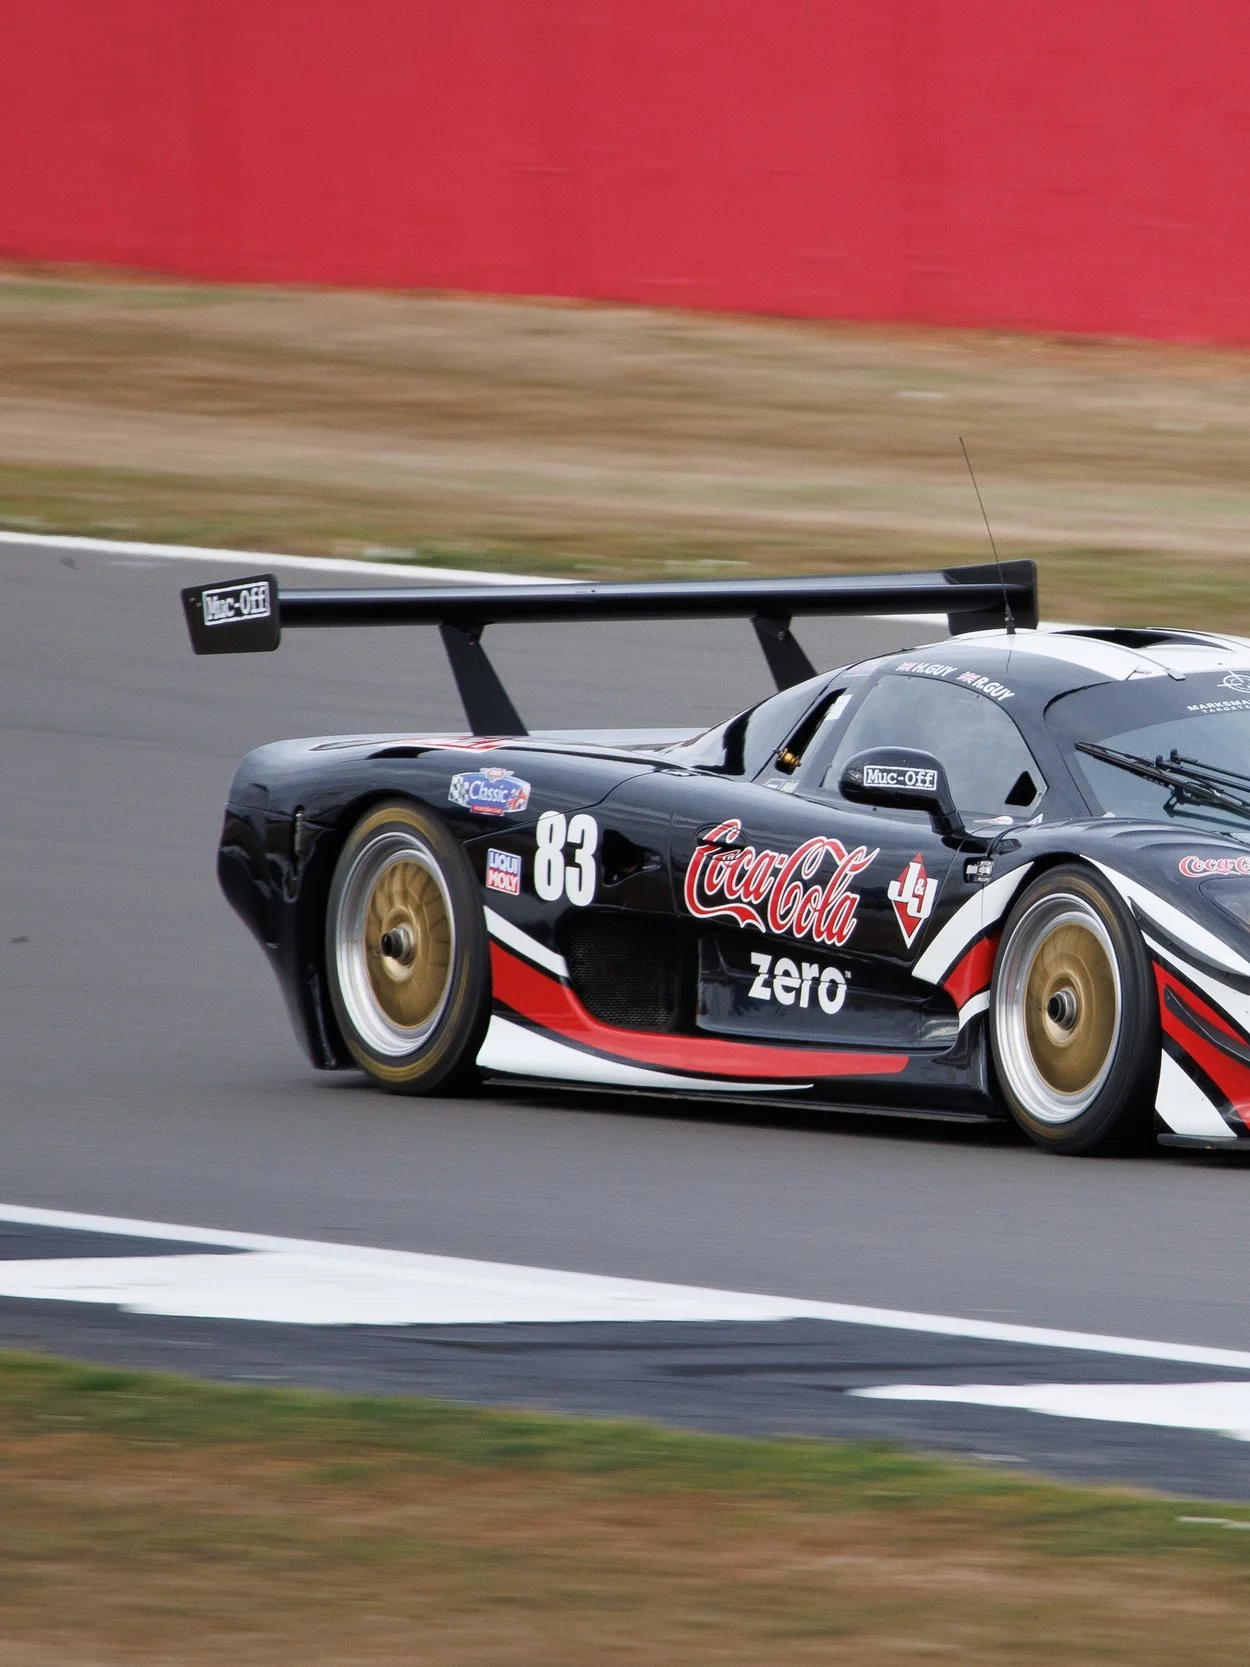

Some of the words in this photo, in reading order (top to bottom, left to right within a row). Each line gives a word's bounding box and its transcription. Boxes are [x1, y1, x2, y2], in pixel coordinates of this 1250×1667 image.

[205, 586, 267, 620] Muc-Off
[911, 662, 957, 677] H.GUY
[972, 675, 1015, 701] R.GUY
[866, 768, 934, 788] Muc-Off
[469, 780, 509, 803] Classic
[489, 851, 519, 874] LIQUI
[534, 811, 598, 906] 83
[488, 870, 519, 892] MOLY
[684, 818, 880, 946] Coca-Cola
